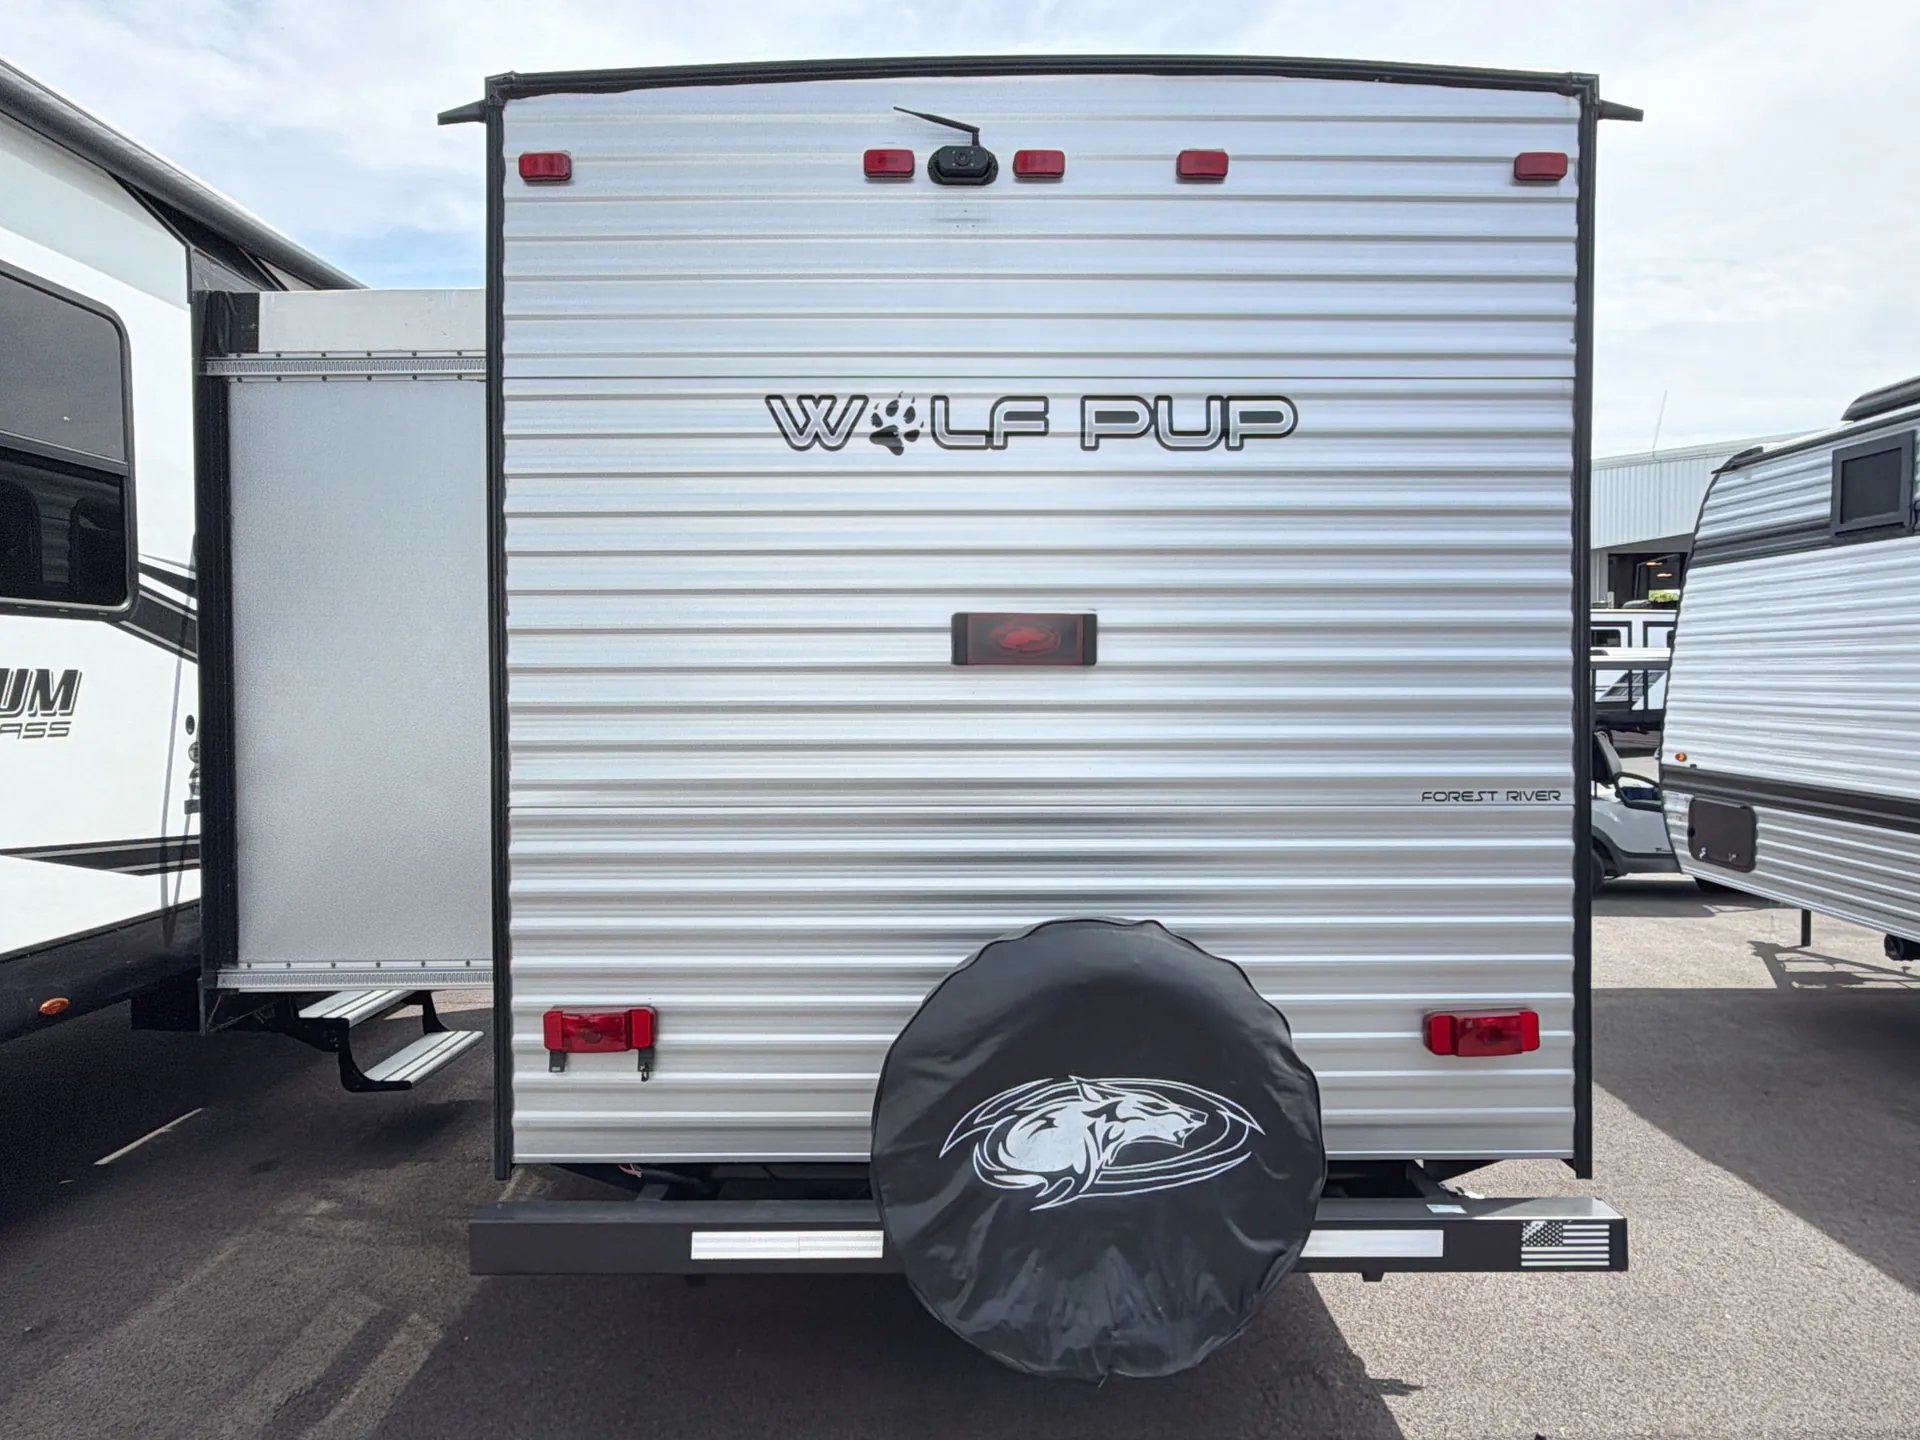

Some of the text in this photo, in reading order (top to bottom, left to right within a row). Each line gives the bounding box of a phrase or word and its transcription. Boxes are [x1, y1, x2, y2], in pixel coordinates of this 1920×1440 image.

[1080, 395, 1298, 452] PUP
[1421, 789, 1562, 802] FOREST RIVER
